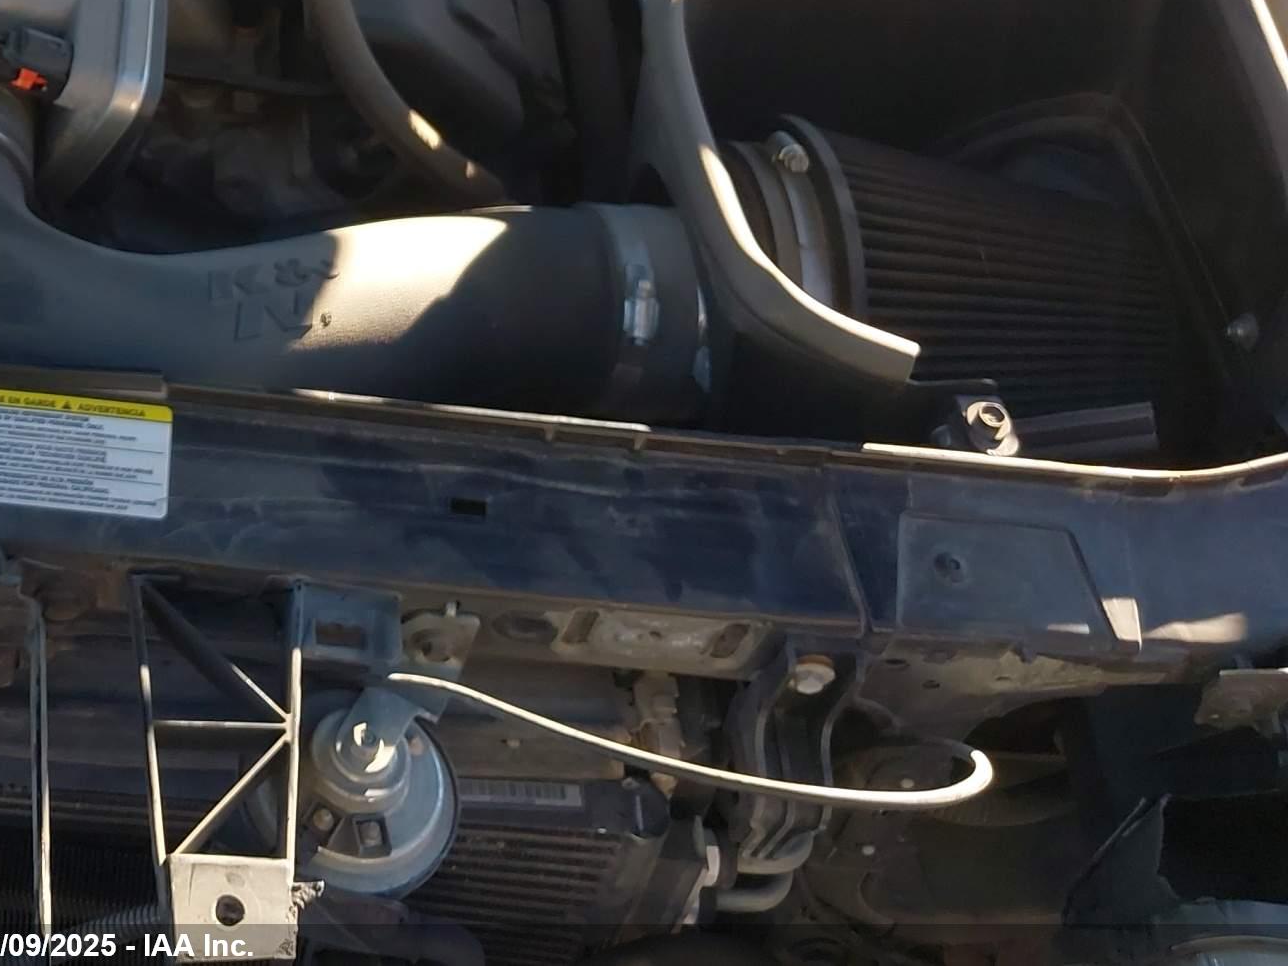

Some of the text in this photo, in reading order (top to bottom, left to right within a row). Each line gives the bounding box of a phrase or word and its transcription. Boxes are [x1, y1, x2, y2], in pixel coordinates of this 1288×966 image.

[8, 394, 22, 405] EN
[24, 396, 57, 408] GARDE
[77, 402, 147, 418] ADVERTENCIA
